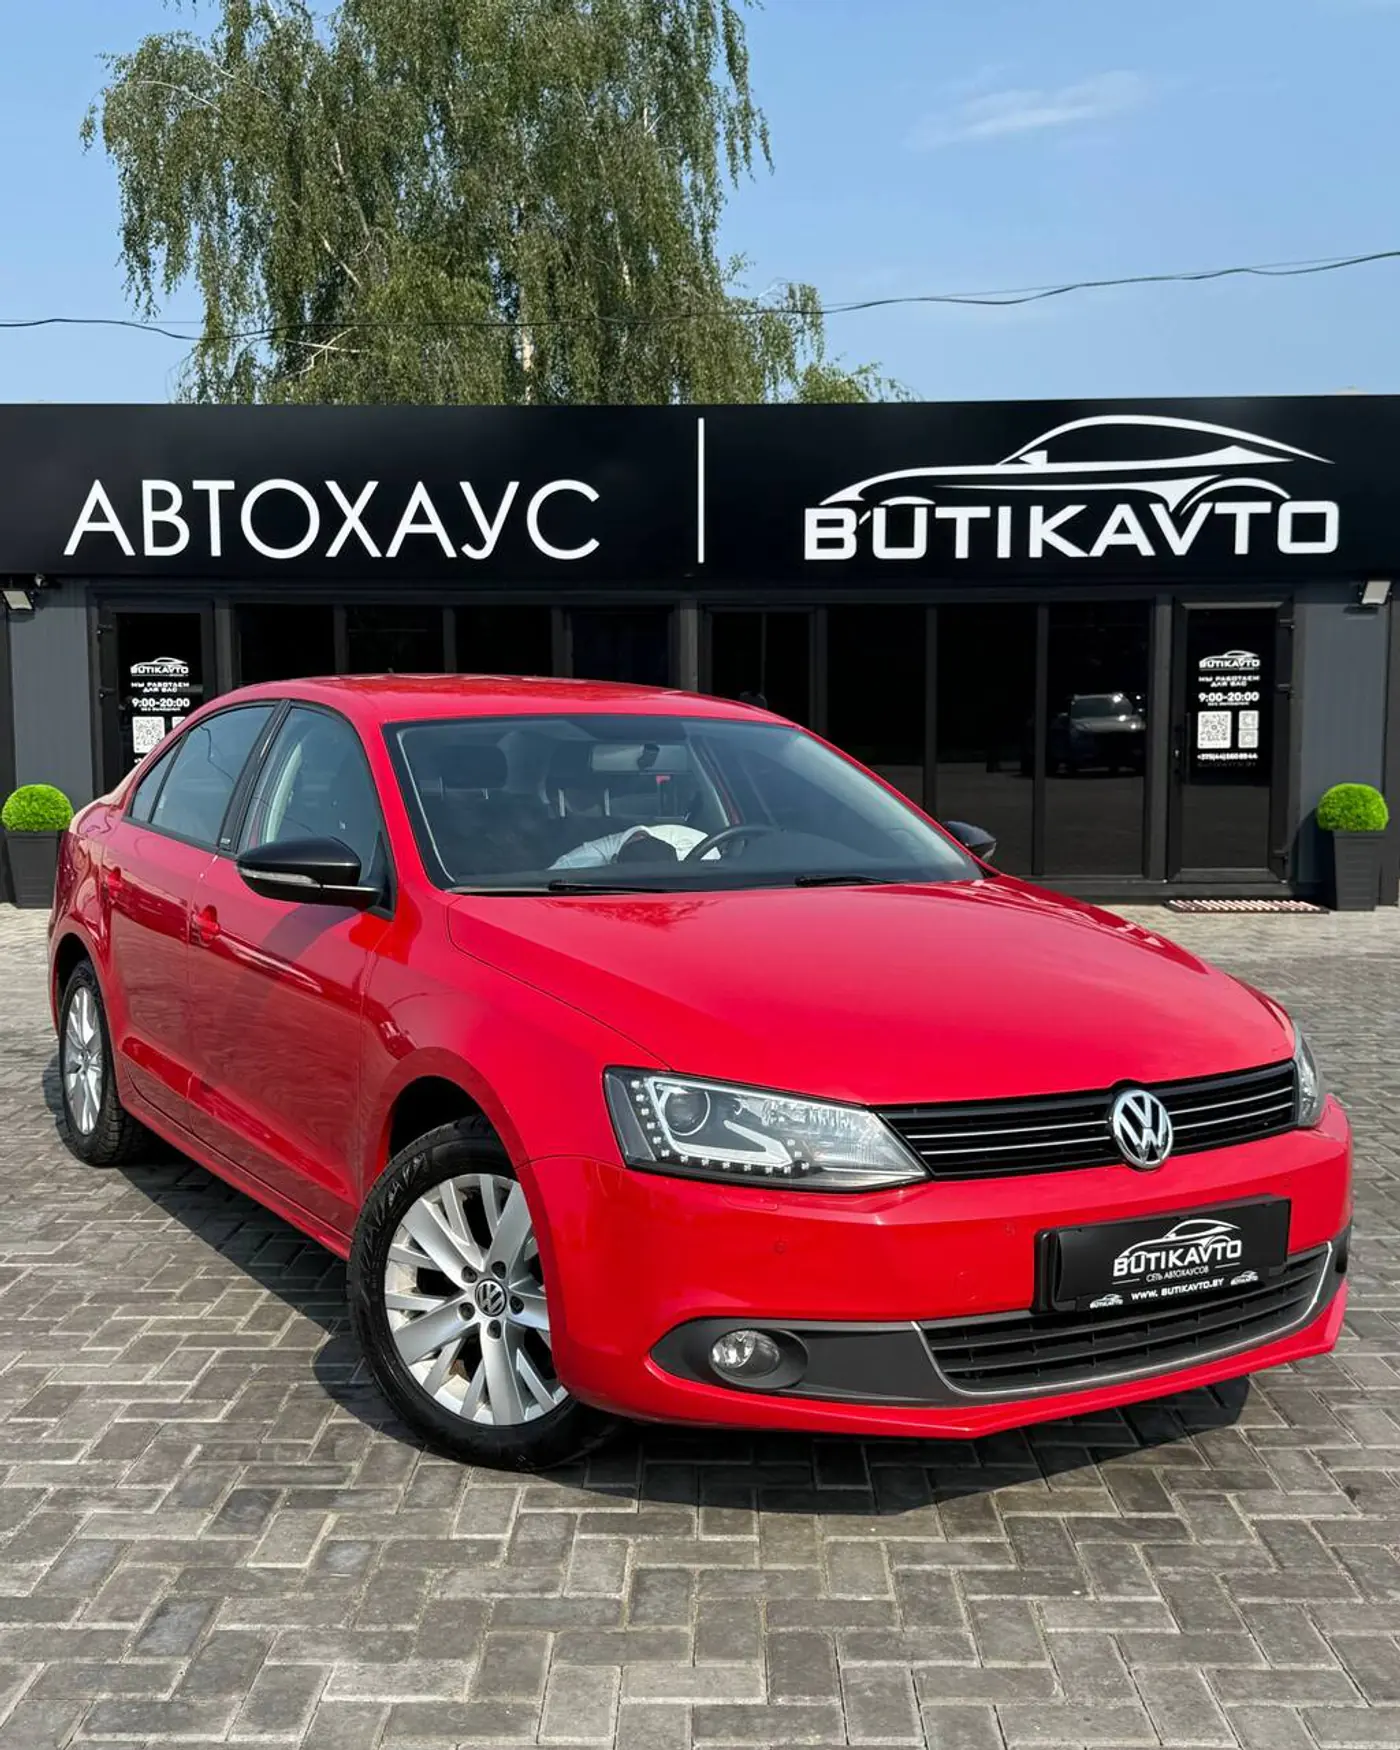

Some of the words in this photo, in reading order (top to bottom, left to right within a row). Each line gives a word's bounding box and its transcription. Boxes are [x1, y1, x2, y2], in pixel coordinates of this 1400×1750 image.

[64, 479, 600, 560] АВТОХАУС
[804, 500, 1340, 561] BUTIKAVTO
[131, 698, 190, 708] 9:00-20:00
[1198, 691, 1260, 703] 9:00-20:00
[1113, 1239, 1242, 1277] BUTIKAVTO
